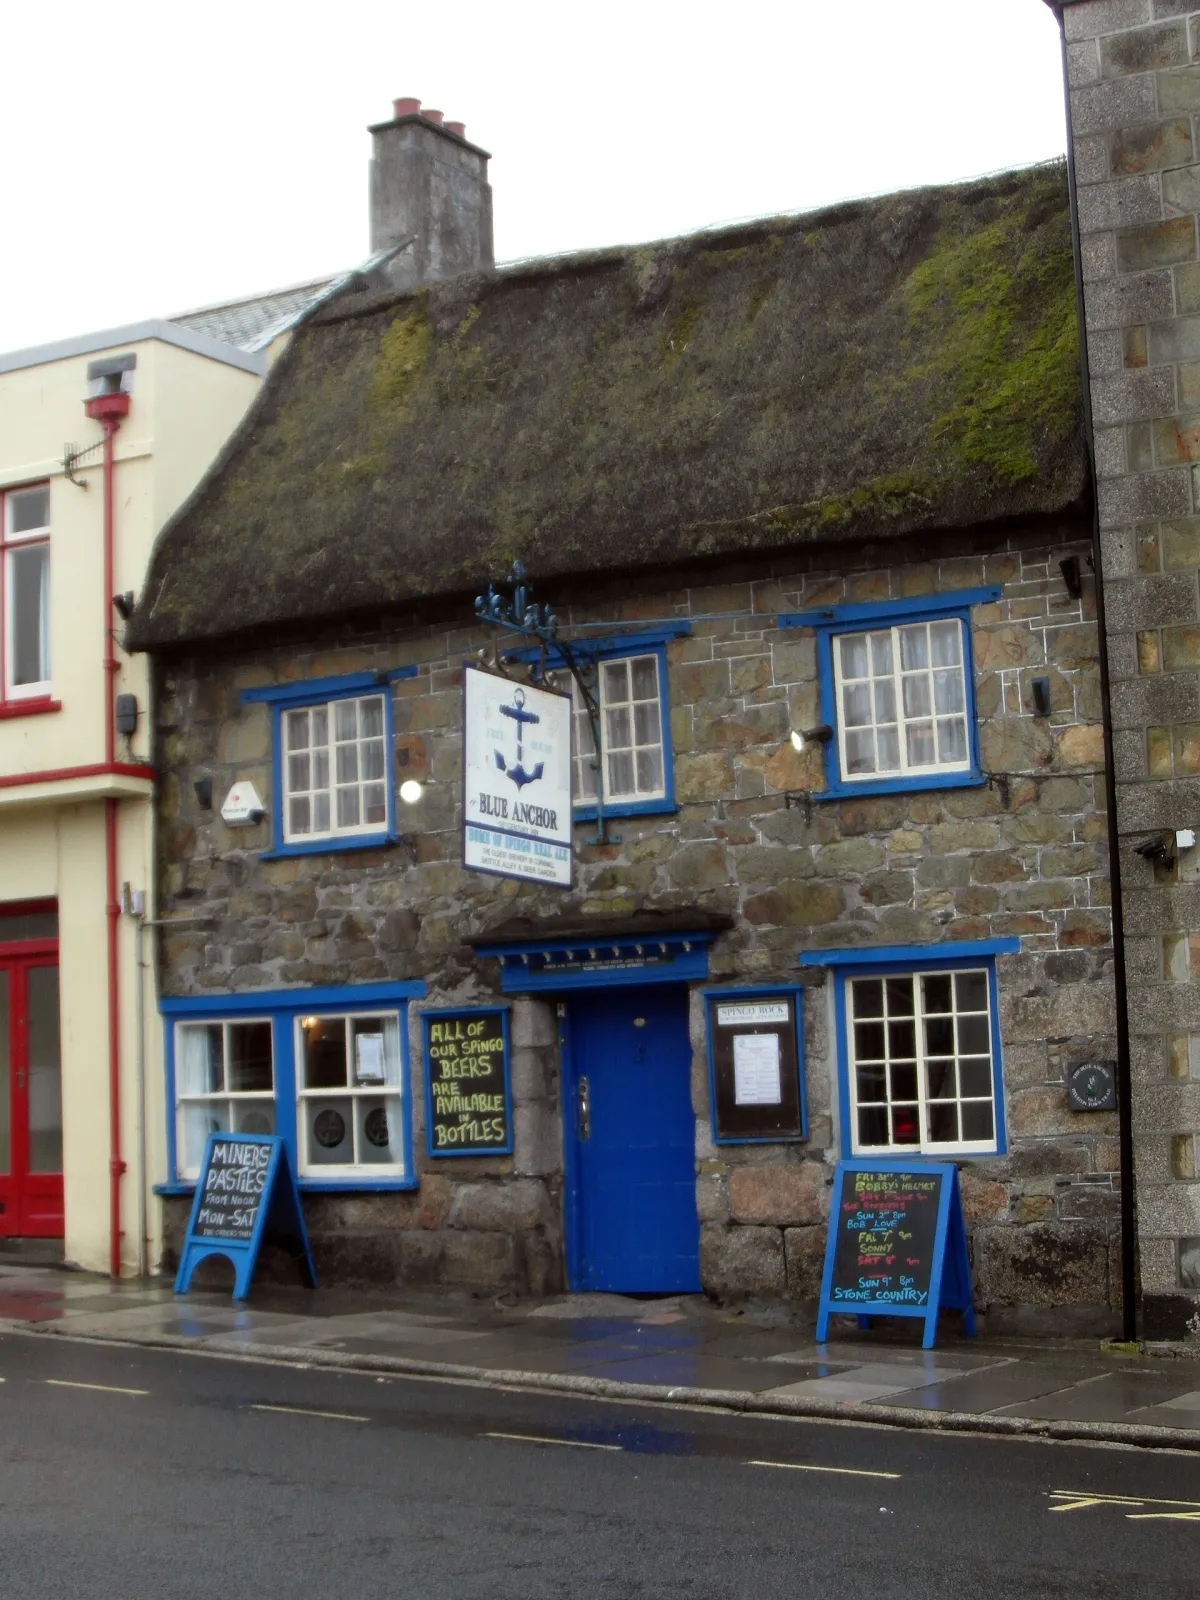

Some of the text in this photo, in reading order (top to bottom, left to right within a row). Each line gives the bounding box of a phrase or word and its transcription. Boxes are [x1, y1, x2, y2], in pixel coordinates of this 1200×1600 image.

[479, 792, 558, 831] BLUE ANCHOR
[523, 865, 537, 873] BEER
[719, 1005, 784, 1016] SPINGO ROCK
[430, 1020, 486, 1042] ALL OF
[430, 1043, 458, 1058] OUR
[439, 1055, 492, 1079] BEERS
[432, 1082, 460, 1096] ARE
[436, 1093, 504, 1116] AVAILABLE
[459, 1114, 470, 1123] IN
[435, 1118, 505, 1146] BOTTLES
[211, 1143, 271, 1168] MINERS
[856, 1173, 873, 1181] FRI
[901, 1182, 936, 1191] HELMET
[205, 1193, 256, 1206] FROM NOON
[856, 1211, 874, 1220] SUN
[847, 1219, 898, 1229] BOB LOVE
[860, 1242, 893, 1253] SONNY
[858, 1255, 881, 1266] SAT
[858, 1276, 879, 1288] SUN
[835, 1287, 928, 1305] STONE COUNTRY
